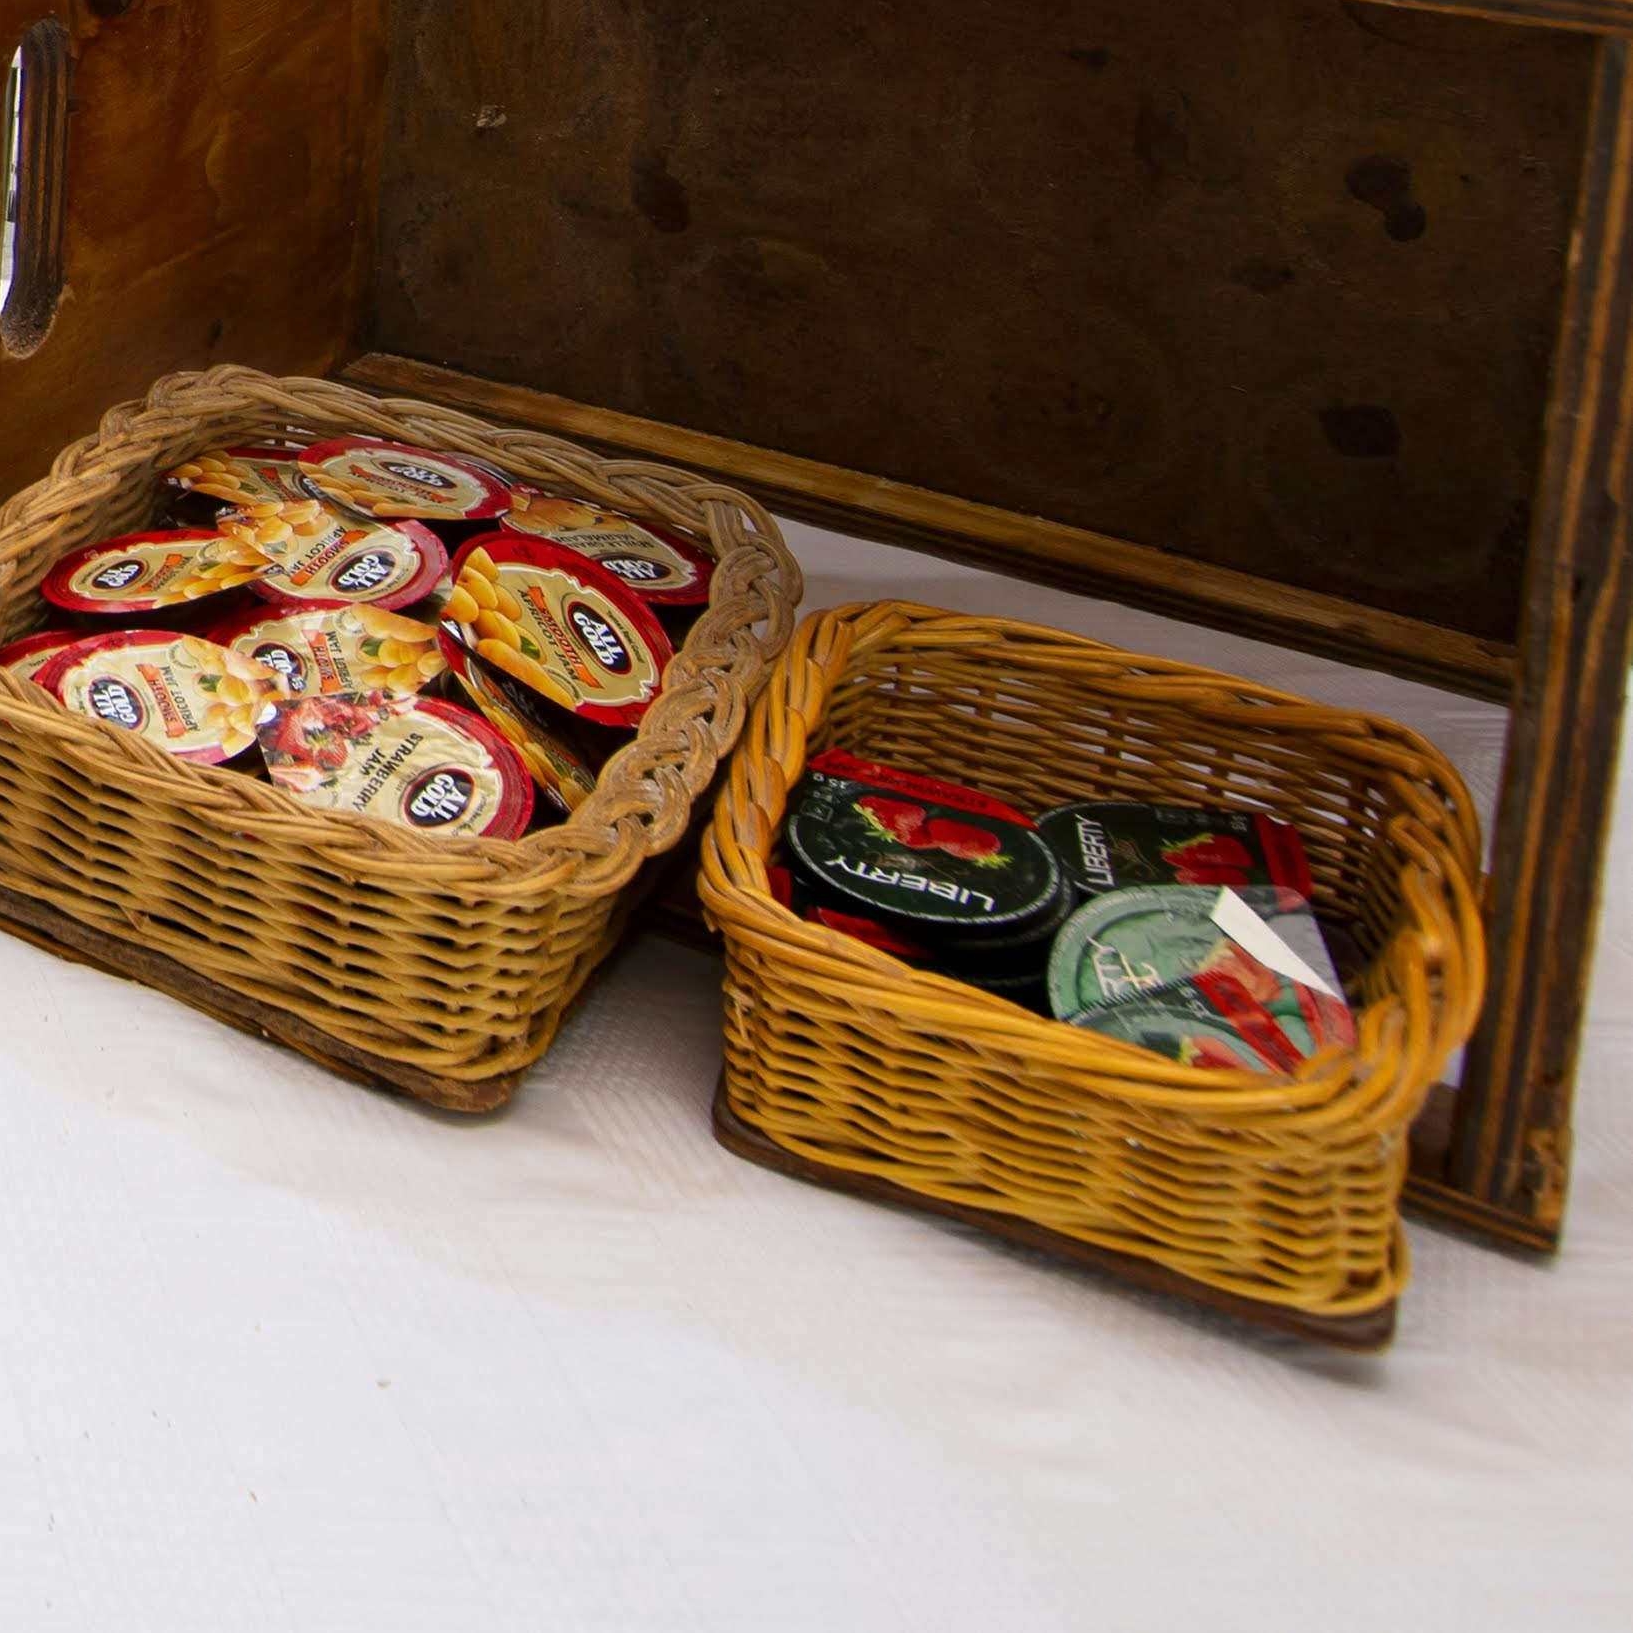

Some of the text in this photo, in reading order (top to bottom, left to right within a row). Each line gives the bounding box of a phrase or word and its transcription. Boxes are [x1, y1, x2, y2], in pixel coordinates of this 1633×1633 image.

[305, 524, 348, 561] APRICOT
[306, 539, 349, 576] SMOOTH
[96, 564, 125, 585] ALL
[108, 563, 141, 588] GOLD
[338, 553, 380, 588] GOLD
[353, 562, 388, 590] ALL
[601, 559, 656, 572] GOLD
[619, 568, 657, 579] ALL
[517, 590, 580, 682] APRICOT JAM
[539, 606, 581, 667] SMOOTH
[572, 611, 615, 667] GOLD
[590, 619, 625, 660] ALL
[92, 689, 120, 720] ALL
[107, 683, 139, 725] GOLD
[149, 677, 178, 724] SMOOTH
[158, 664, 201, 731] APRICOT JAM
[351, 731, 425, 813] STRAWBERRY
[359, 747, 386, 777] JAM
[410, 771, 456, 819] GOLD
[430, 788, 468, 822] ALL
[1075, 813, 1115, 886] LIBERTY
[823, 854, 995, 912] LIBERTY
